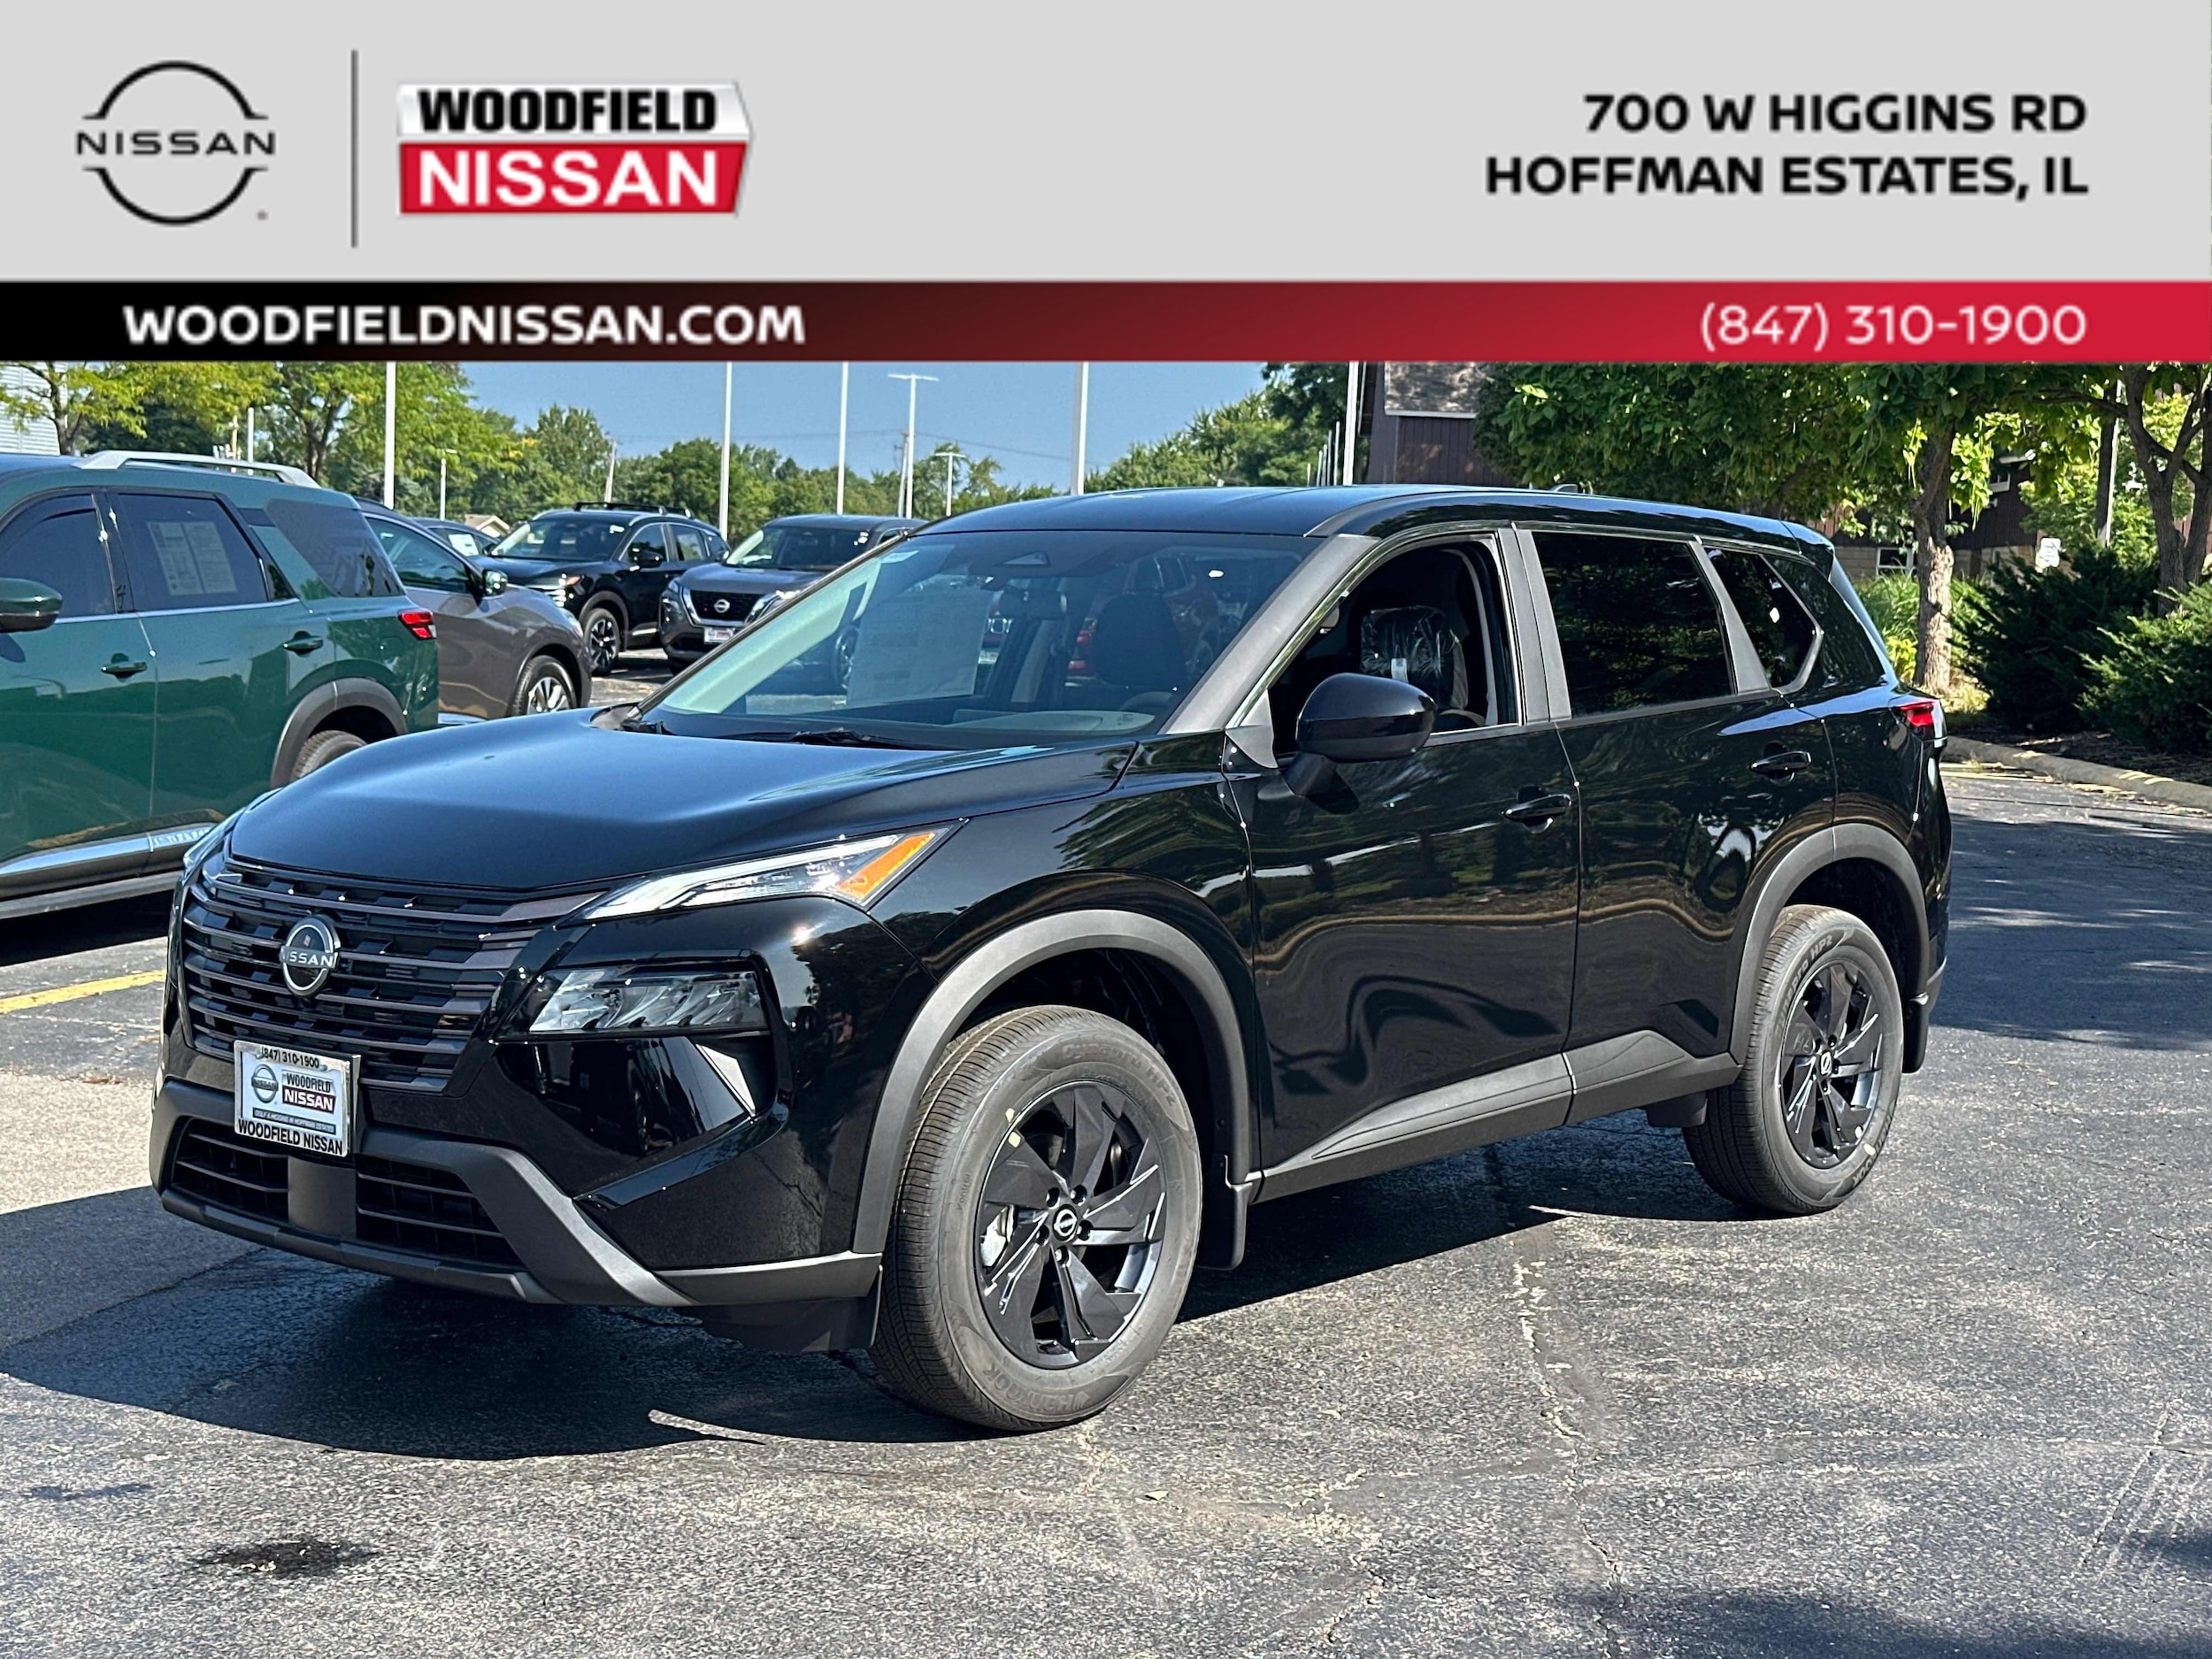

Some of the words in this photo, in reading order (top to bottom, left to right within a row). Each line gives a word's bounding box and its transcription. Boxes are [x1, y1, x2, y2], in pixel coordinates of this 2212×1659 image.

[261, 1046, 281, 1061] (847)
[282, 1051, 320, 1069] 310-1900
[286, 1072, 332, 1094] WOODFIELD
[284, 1088, 334, 1111] NISSAN
[238, 1118, 301, 1145] WOODFIELD
[303, 1133, 342, 1156] NISSAN
